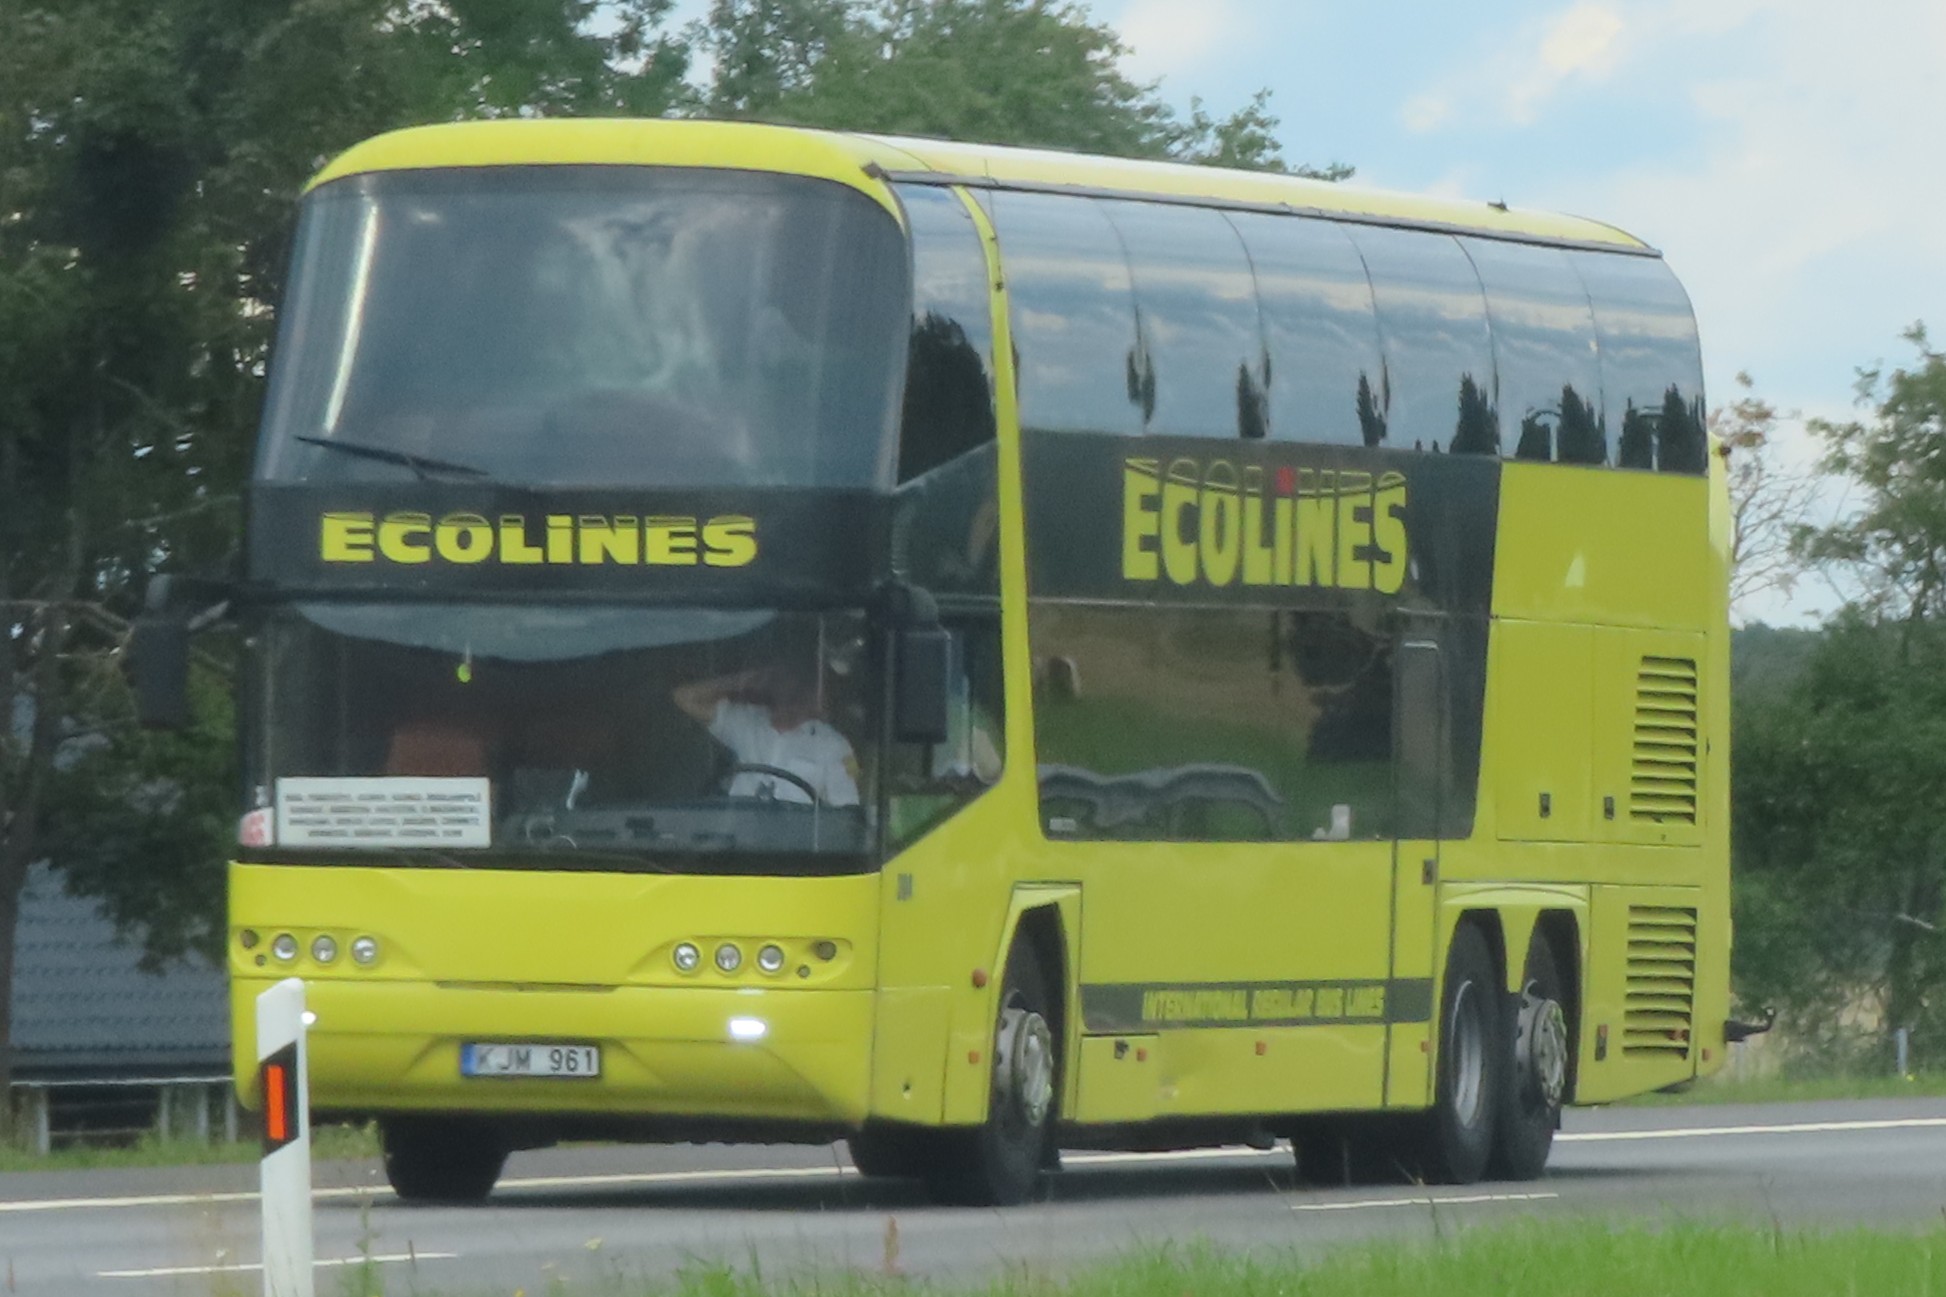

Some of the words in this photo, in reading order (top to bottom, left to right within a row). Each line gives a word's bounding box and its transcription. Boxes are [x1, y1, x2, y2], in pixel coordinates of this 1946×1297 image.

[1122, 457, 1407, 595] ECOLINES
[476, 1048, 532, 1071] KJM
[549, 1048, 593, 1072] 961
